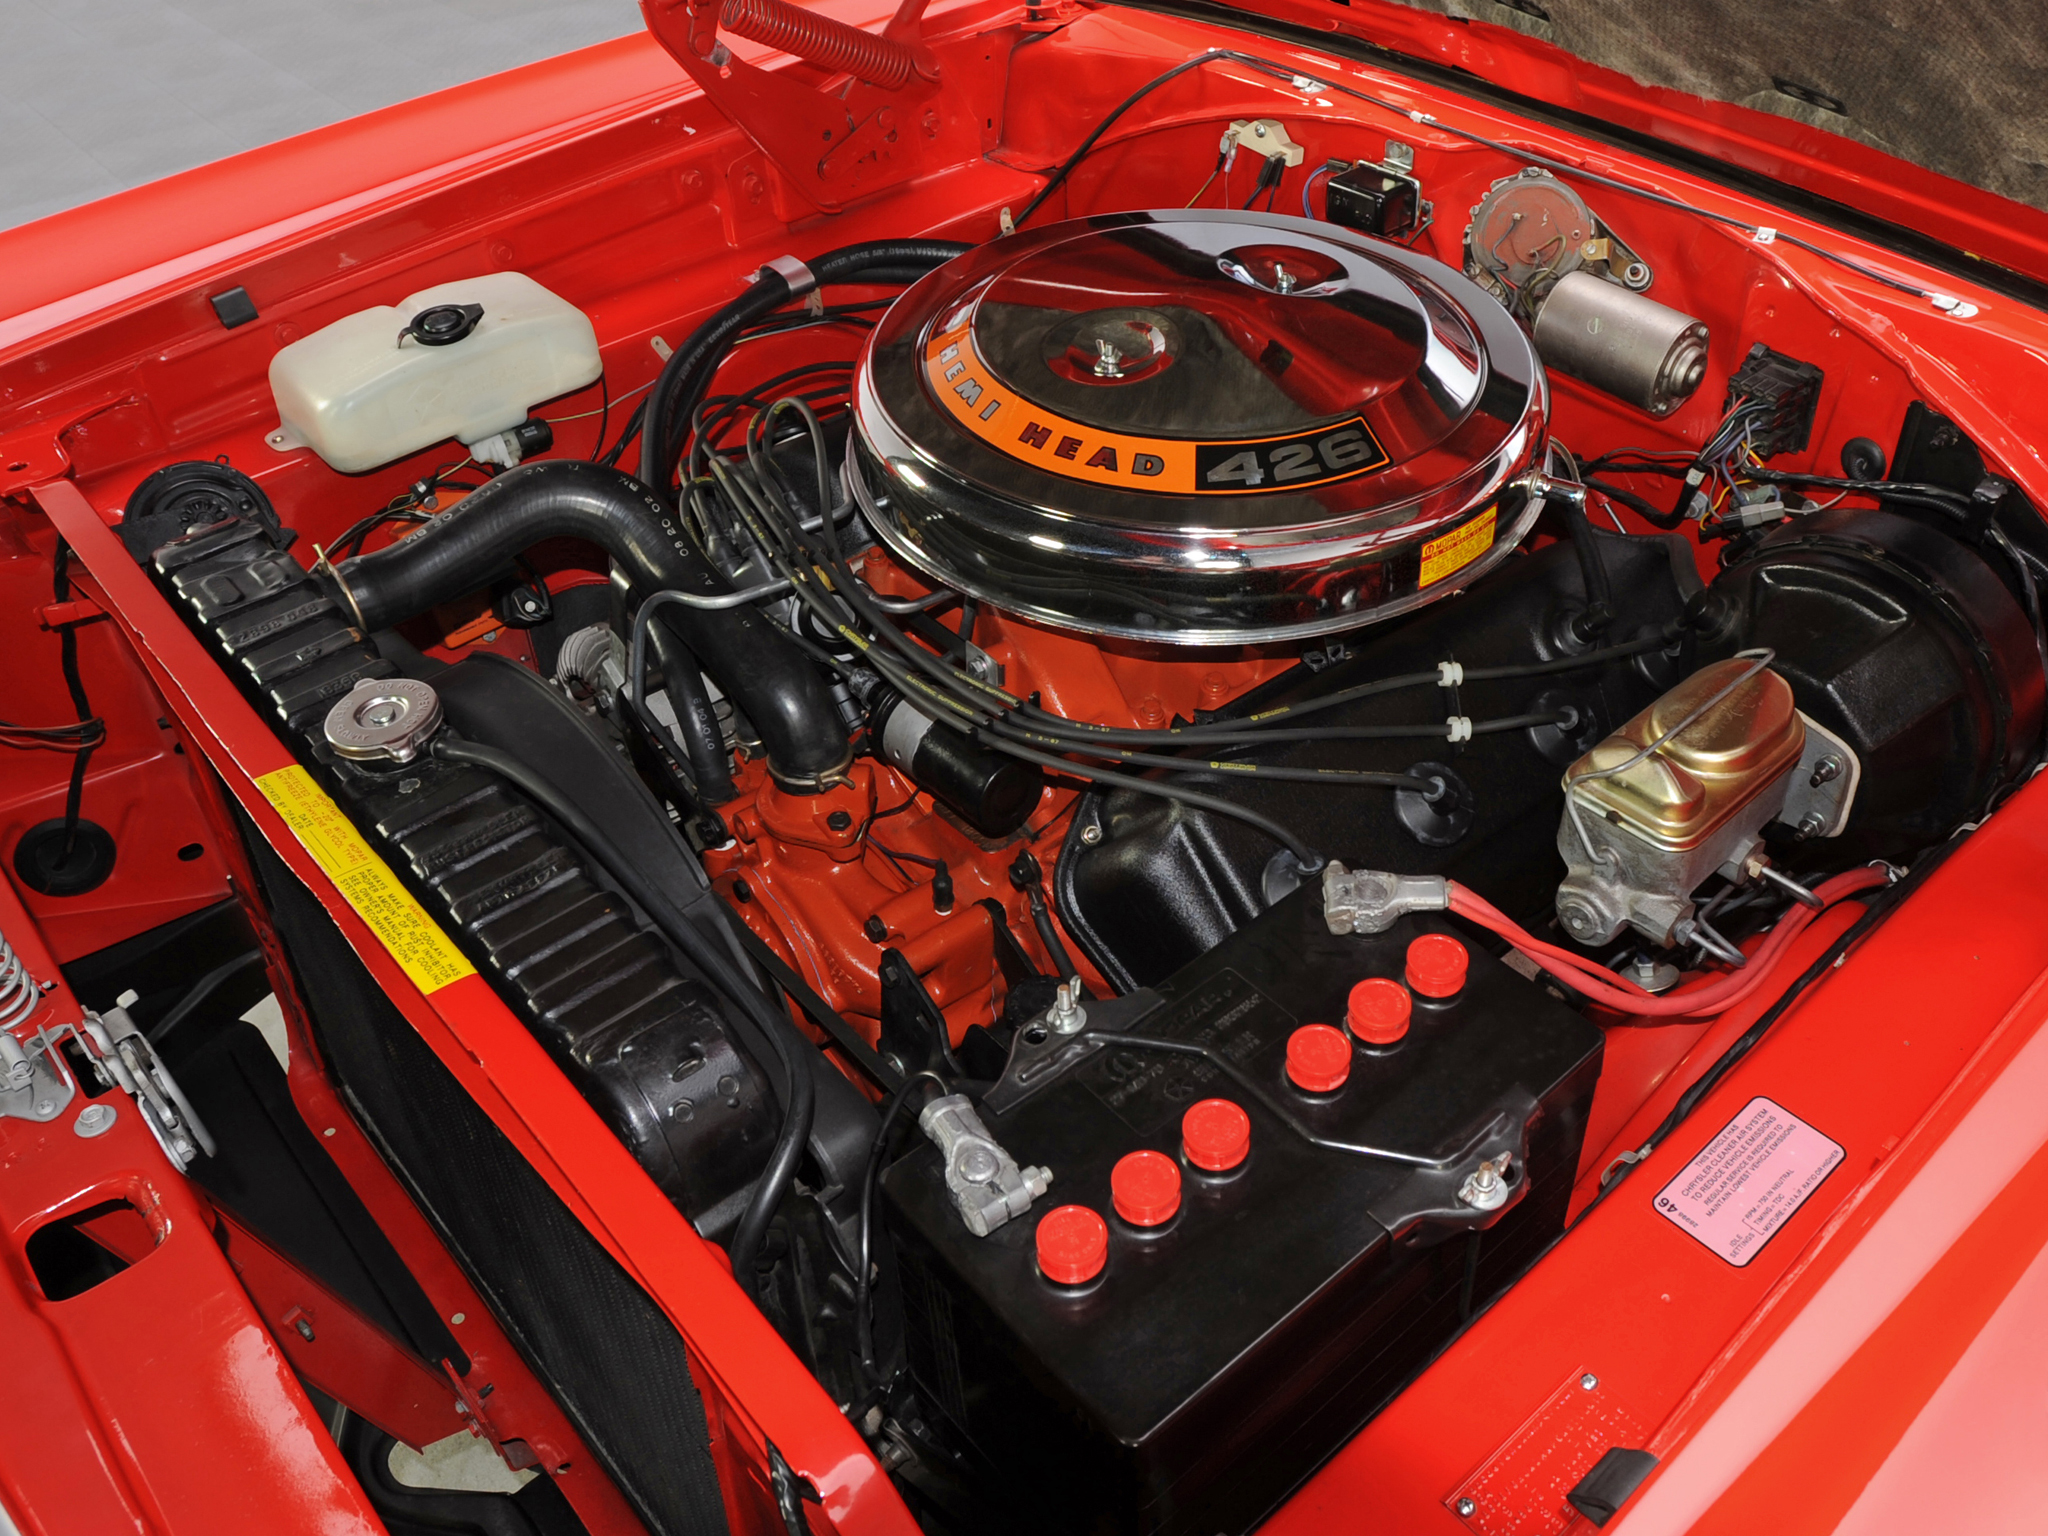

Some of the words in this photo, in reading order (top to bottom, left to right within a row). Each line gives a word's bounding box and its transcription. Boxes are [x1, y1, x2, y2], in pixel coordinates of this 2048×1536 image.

[821, 256, 847, 272] HEATER
[849, 250, 869, 261] HOSE
[706, 313, 740, 343] GOODYEAR
[938, 341, 1001, 423] HEMI
[1017, 422, 1165, 477] HEAD
[1206, 428, 1374, 486] 426
[642, 493, 662, 514] 02
[658, 516, 679, 537] 20
[1437, 531, 1461, 550] MOPAR
[671, 538, 691, 558] 08
[377, 683, 393, 691] DO
[397, 682, 419, 692] NOT
[905, 674, 936, 696] ELECTRONIC
[937, 694, 974, 716] SUPPRESSION
[953, 671, 984, 688] ELECTRONIC
[984, 685, 1017, 705] SUPPRESSIO
[705, 738, 714, 749] 07
[257, 777, 281, 801] CHECKED
[283, 809, 304, 830] DEALER
[274, 771, 303, 800] ANTIFREEZE
[298, 799, 326, 828] (ETHYLENE
[323, 827, 344, 848] GLYCOL
[341, 848, 359, 865] TYPE)
[282, 768, 310, 797] PROTECTED
[309, 799, 320, 808] TO
[332, 825, 348, 840] WITH
[347, 842, 368, 861] MOPAR
[298, 813, 313, 827] DATE
[314, 792, 341, 819] IMPORTANT
[339, 878, 365, 904] SYSTEMS
[361, 904, 413, 963] RECOMMENDATIONS
[356, 871, 379, 893] PROPER
[376, 894, 401, 919] AMOUNT
[397, 919, 410, 929] OF
[406, 930, 424, 947] RUST
[365, 867, 388, 890] ALWAYS
[386, 892, 405, 909] MAKE
[403, 911, 421, 928] SURE
[419, 930, 447, 960] COOLANT
[445, 962, 461, 976] HAS
[406, 903, 431, 928] WARNING
[348, 874, 361, 886] SEE
[358, 887, 385, 914] OWNER'S
[381, 915, 406, 940] MANUAL
[403, 942, 419, 955] FOR
[415, 956, 444, 985] COOLING
[1680, 1164, 1713, 1196] CHRYSLER
[1709, 1139, 1739, 1167] CLEANER
[1735, 1129, 1748, 1140] AIR
[1744, 1108, 1768, 1130] SYSTEM
[1691, 1191, 1703, 1202] TO
[1699, 1168, 1725, 1193] REDUCE
[1721, 1144, 1748, 1170] VEHICLE
[1744, 1115, 1777, 1146] EMISSIONS
[1694, 1154, 1709, 1167] THIS
[1706, 1134, 1729, 1156] VEHICLE
[1725, 1123, 1739, 1135] HAS
[1702, 1180, 1729, 1205] REGULAR
[1725, 1159, 1749, 1182] SERVICE
[1750, 1130, 1777, 1156] REQUIRED
[1773, 1123, 1783, 1132] TO
[1705, 1190, 1732, 1217] MAINTAIN
[1729, 1170, 1752, 1192] LOWEST
[1749, 1149, 1772, 1171] VEHICLE
[1768, 1123, 1797, 1150] EMISSIONS
[1657, 1197, 1679, 1214] 46
[1744, 1206, 1757, 1219] RPM
[1757, 1195, 1768, 1205] 750
[1770, 1168, 1794, 1191] NEUTRAL
[1753, 1206, 1772, 1225] TIMING
[1772, 1193, 1785, 1204] TDC
[1762, 1210, 1784, 1232] MIXTURE
[1801, 1173, 1817, 1189] RATIO
[1813, 1166, 1823, 1175] OR
[1820, 1149, 1840, 1168] HIGHER
[1728, 1233, 1743, 1247] IDLE
[1729, 1232, 1755, 1258] SETTINGS
